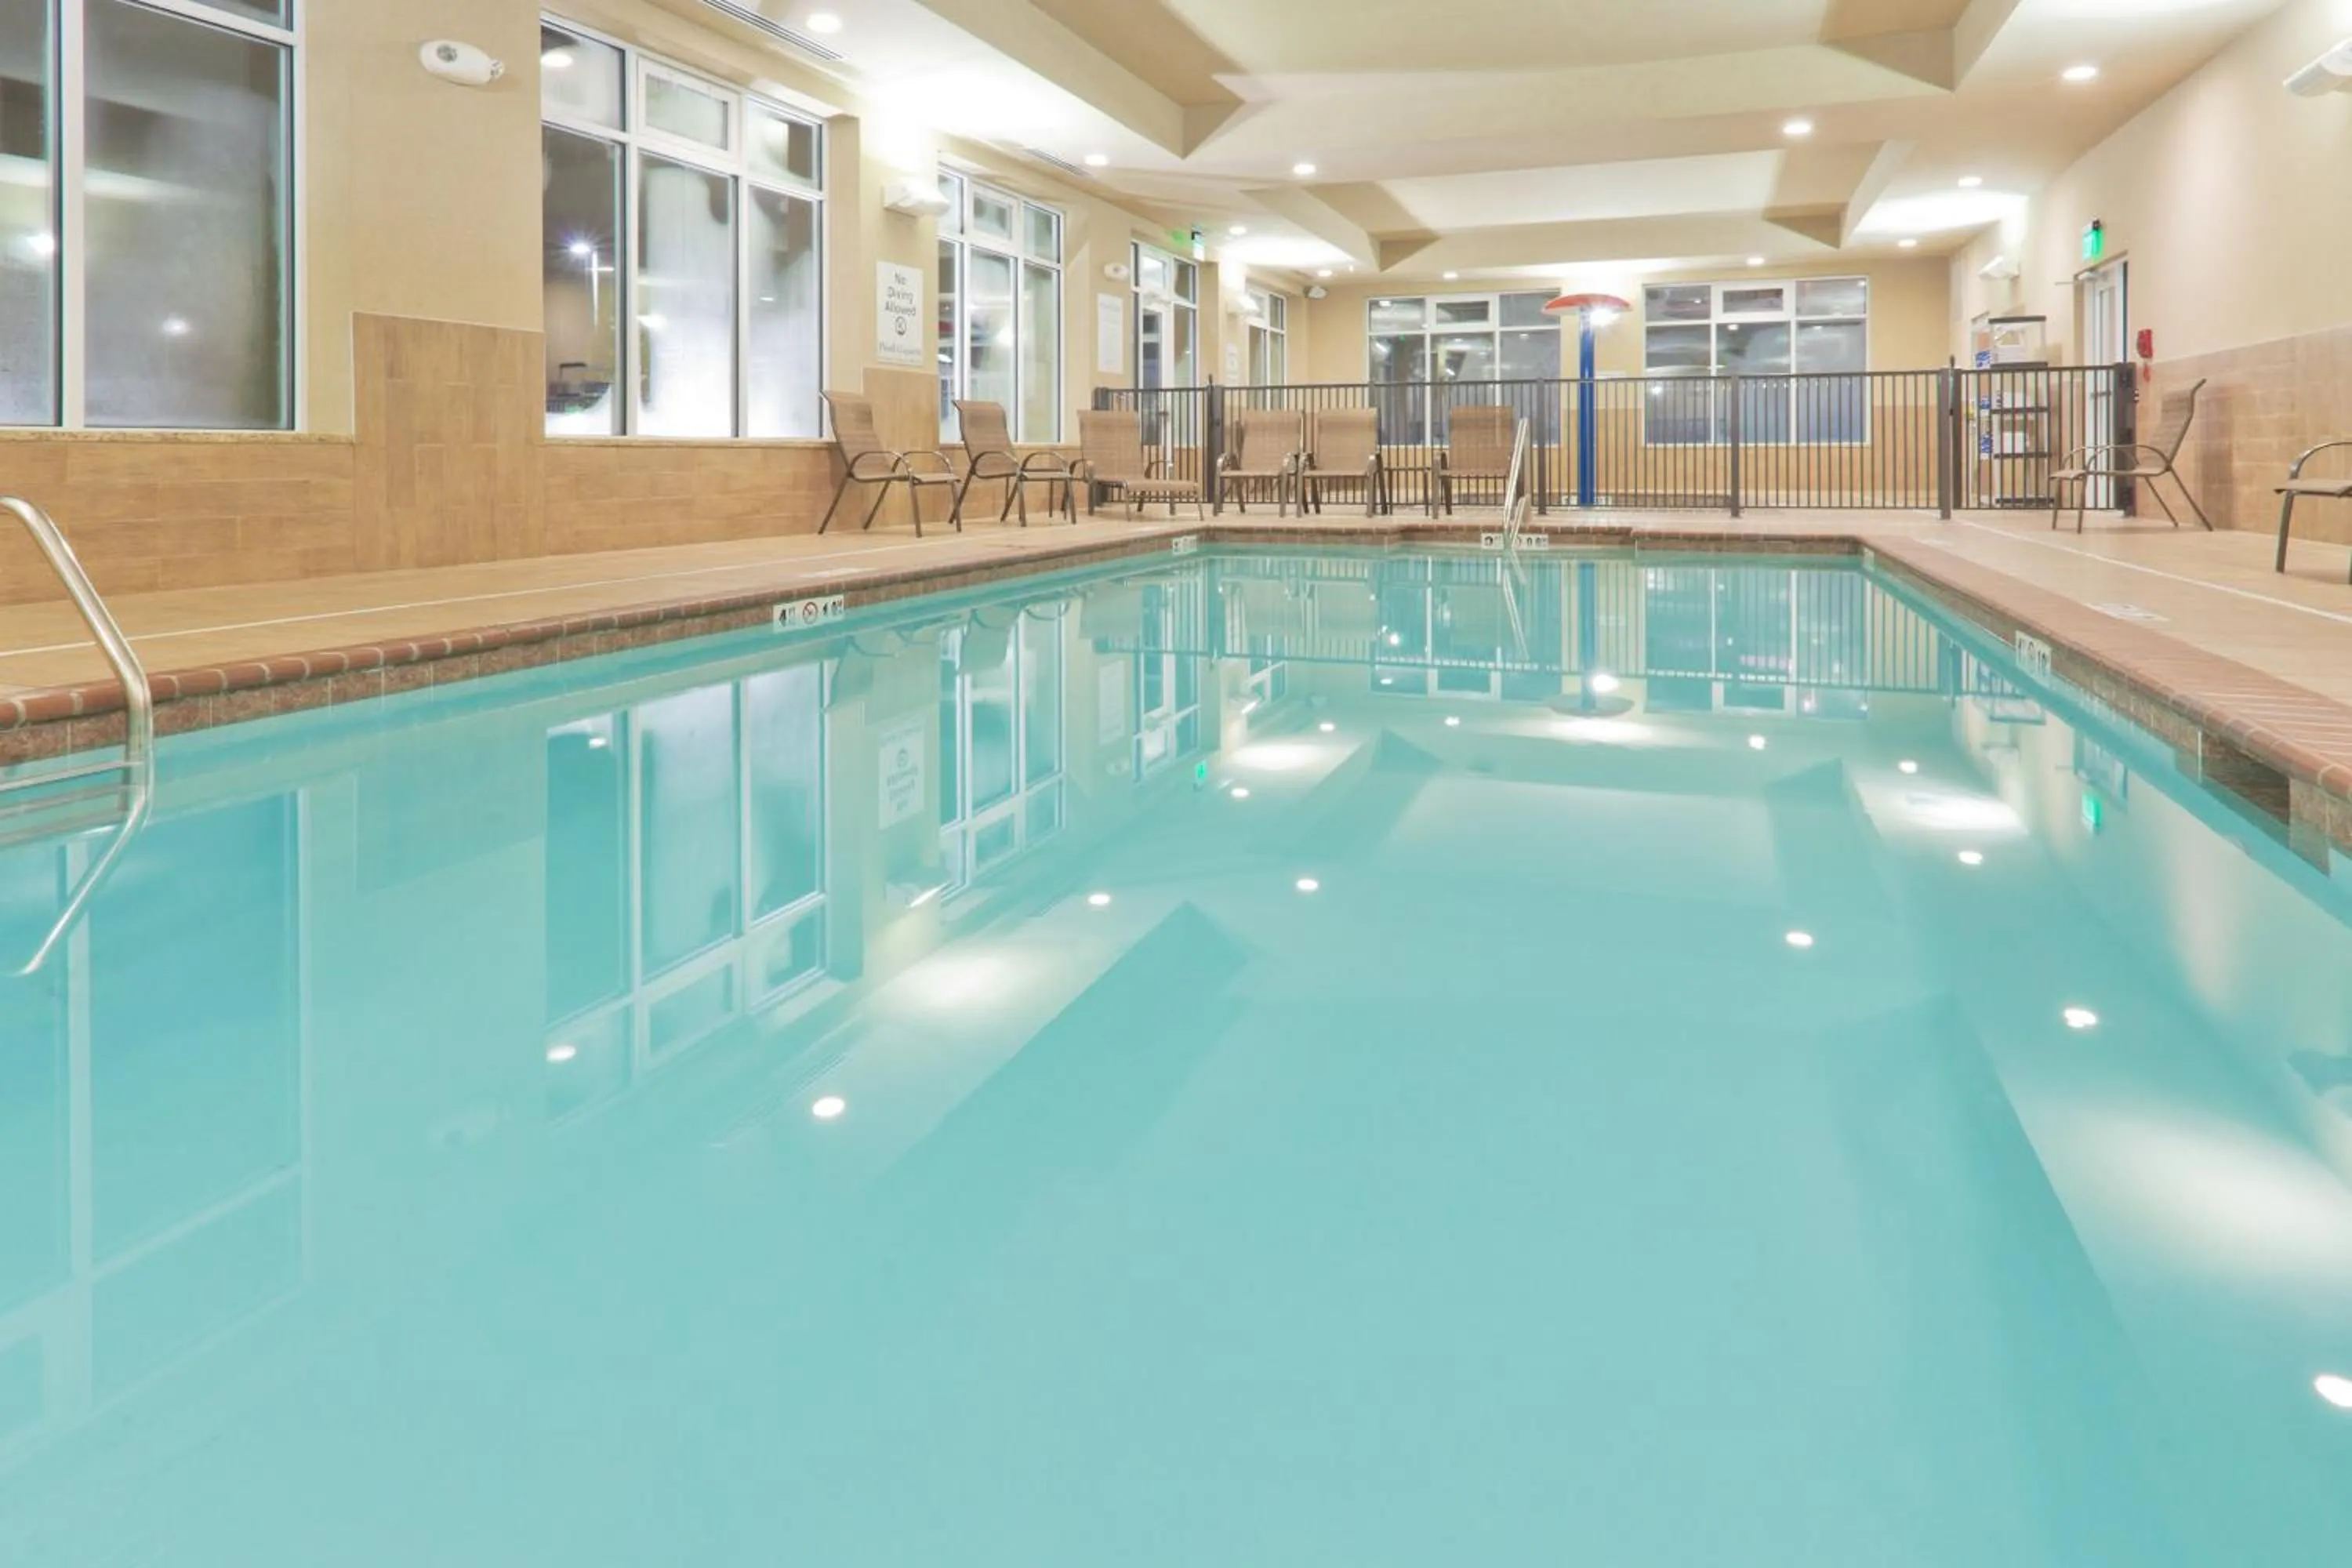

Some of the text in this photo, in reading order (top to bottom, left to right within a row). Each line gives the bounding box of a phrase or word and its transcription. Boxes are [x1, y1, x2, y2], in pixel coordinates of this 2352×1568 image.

[895, 272, 907, 285] No
[887, 285, 913, 305] Diving
[884, 300, 916, 317] Allowed
